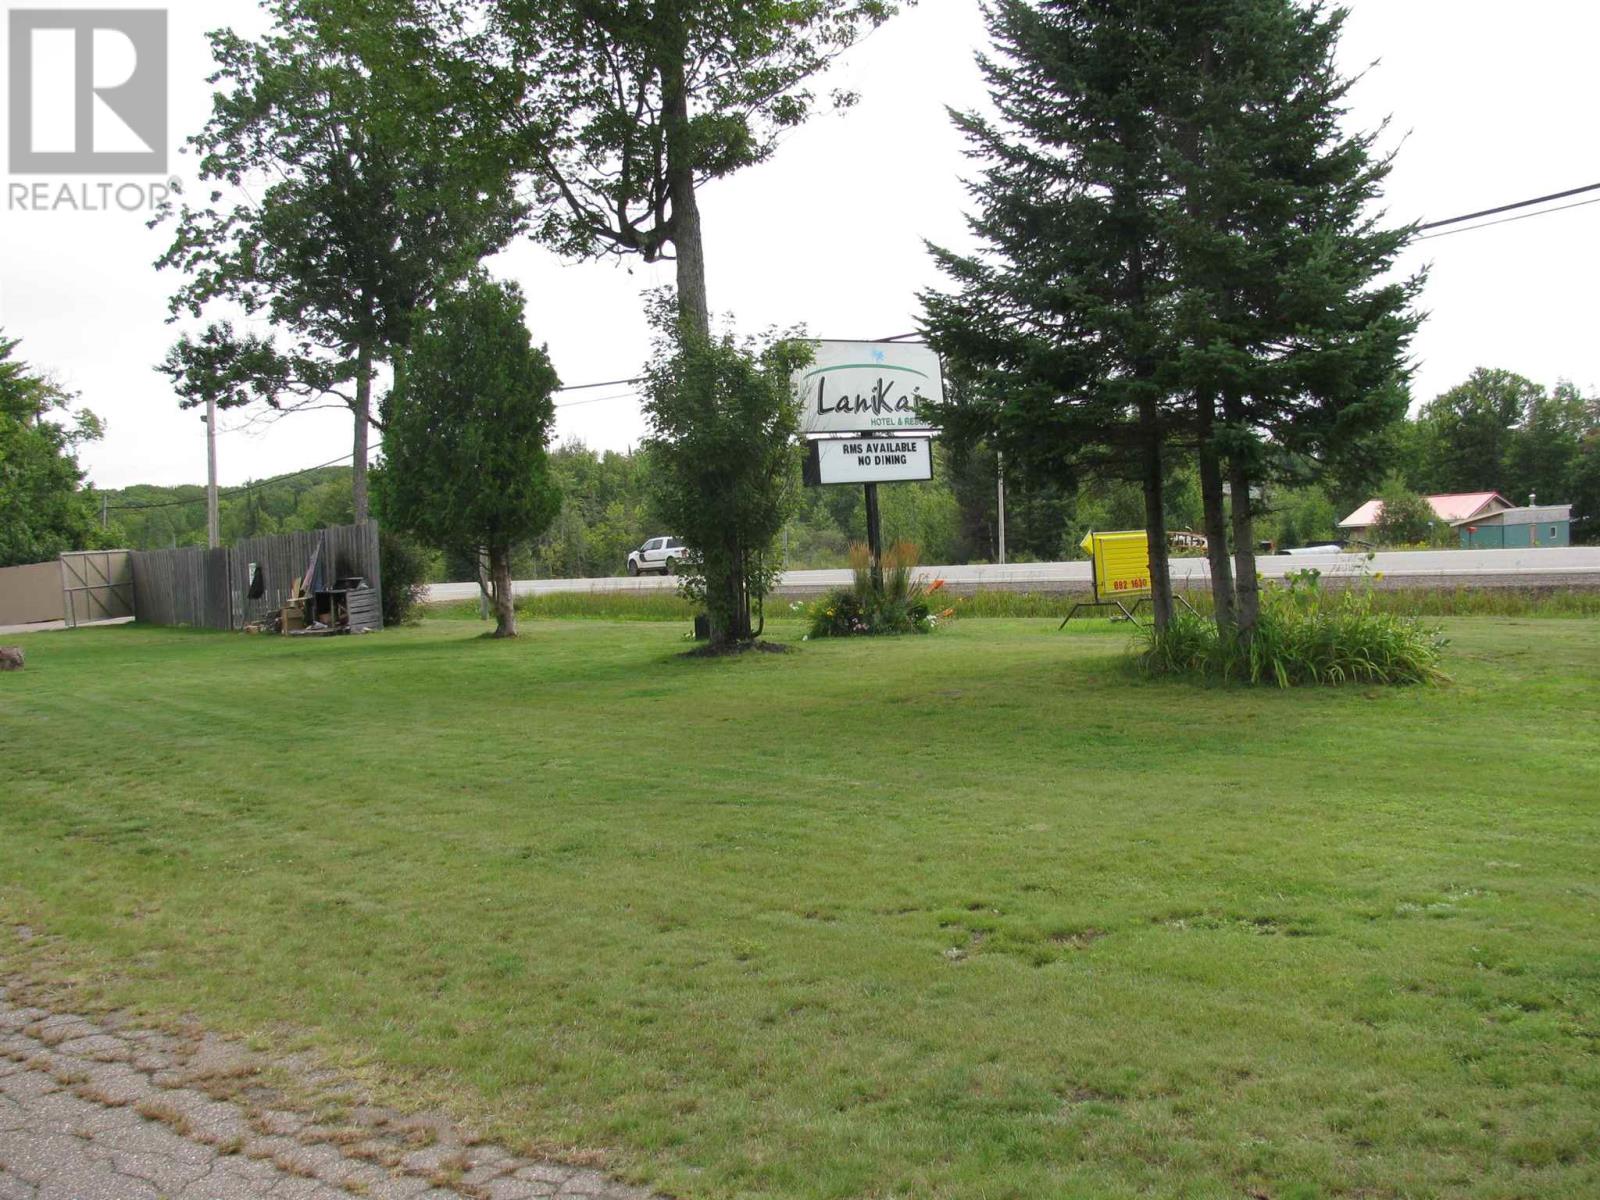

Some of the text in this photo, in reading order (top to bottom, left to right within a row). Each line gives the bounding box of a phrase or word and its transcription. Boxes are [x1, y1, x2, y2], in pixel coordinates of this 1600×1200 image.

[870, 417, 895, 426] HOTEL
[897, 417, 903, 426] &
[843, 442, 917, 454] RMS AVAILABLE
[858, 454, 907, 466] NO DINING
